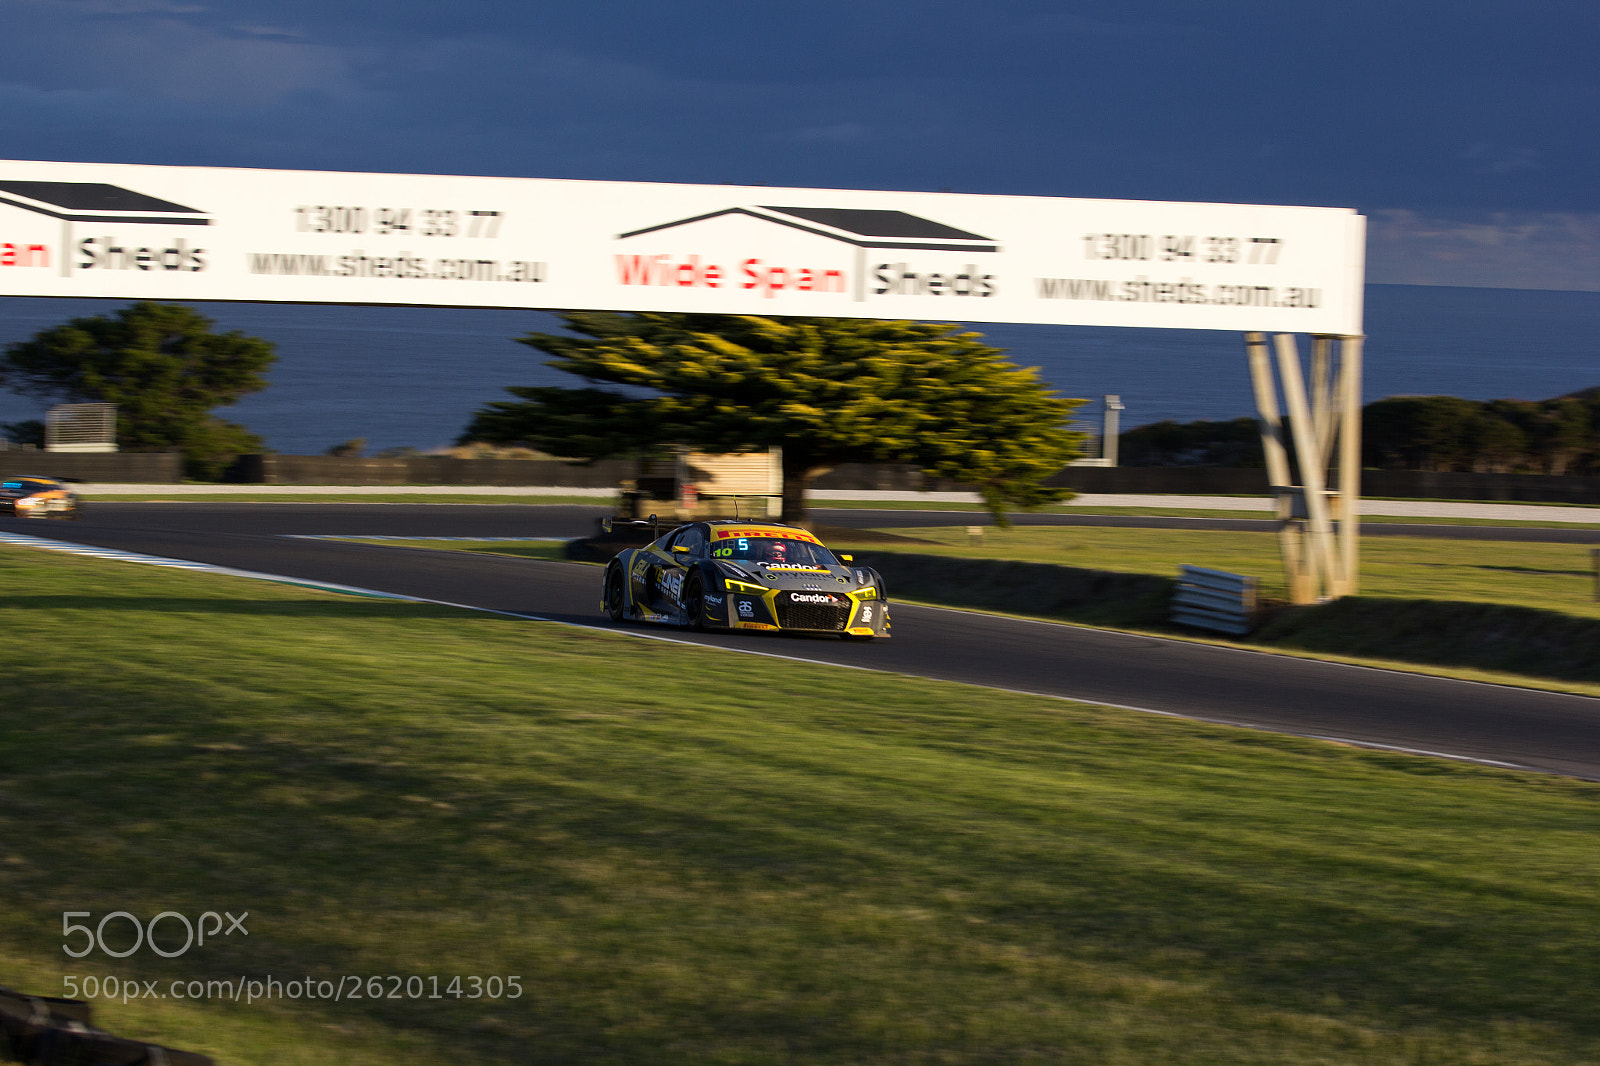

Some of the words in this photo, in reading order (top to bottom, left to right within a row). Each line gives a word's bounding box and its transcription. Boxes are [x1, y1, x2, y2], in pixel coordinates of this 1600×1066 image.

[294, 205, 366, 233] 1300
[375, 207, 413, 235] 94
[420, 209, 459, 237] 33
[465, 210, 506, 239] 77
[79, 236, 207, 272] Sheds
[249, 249, 548, 283] www.sheds.com.au
[1082, 233, 1152, 261] 1300
[1160, 235, 1196, 262] 94
[1203, 236, 1241, 264] 33
[1248, 237, 1283, 265] 77
[614, 254, 726, 289] Wide
[740, 258, 848, 299] Span
[872, 262, 998, 298] Sheds
[1034, 275, 1323, 309] www.sheds.com.au
[714, 548, 733, 558] 10
[738, 539, 749, 551] 5
[790, 592, 829, 603] Candor
